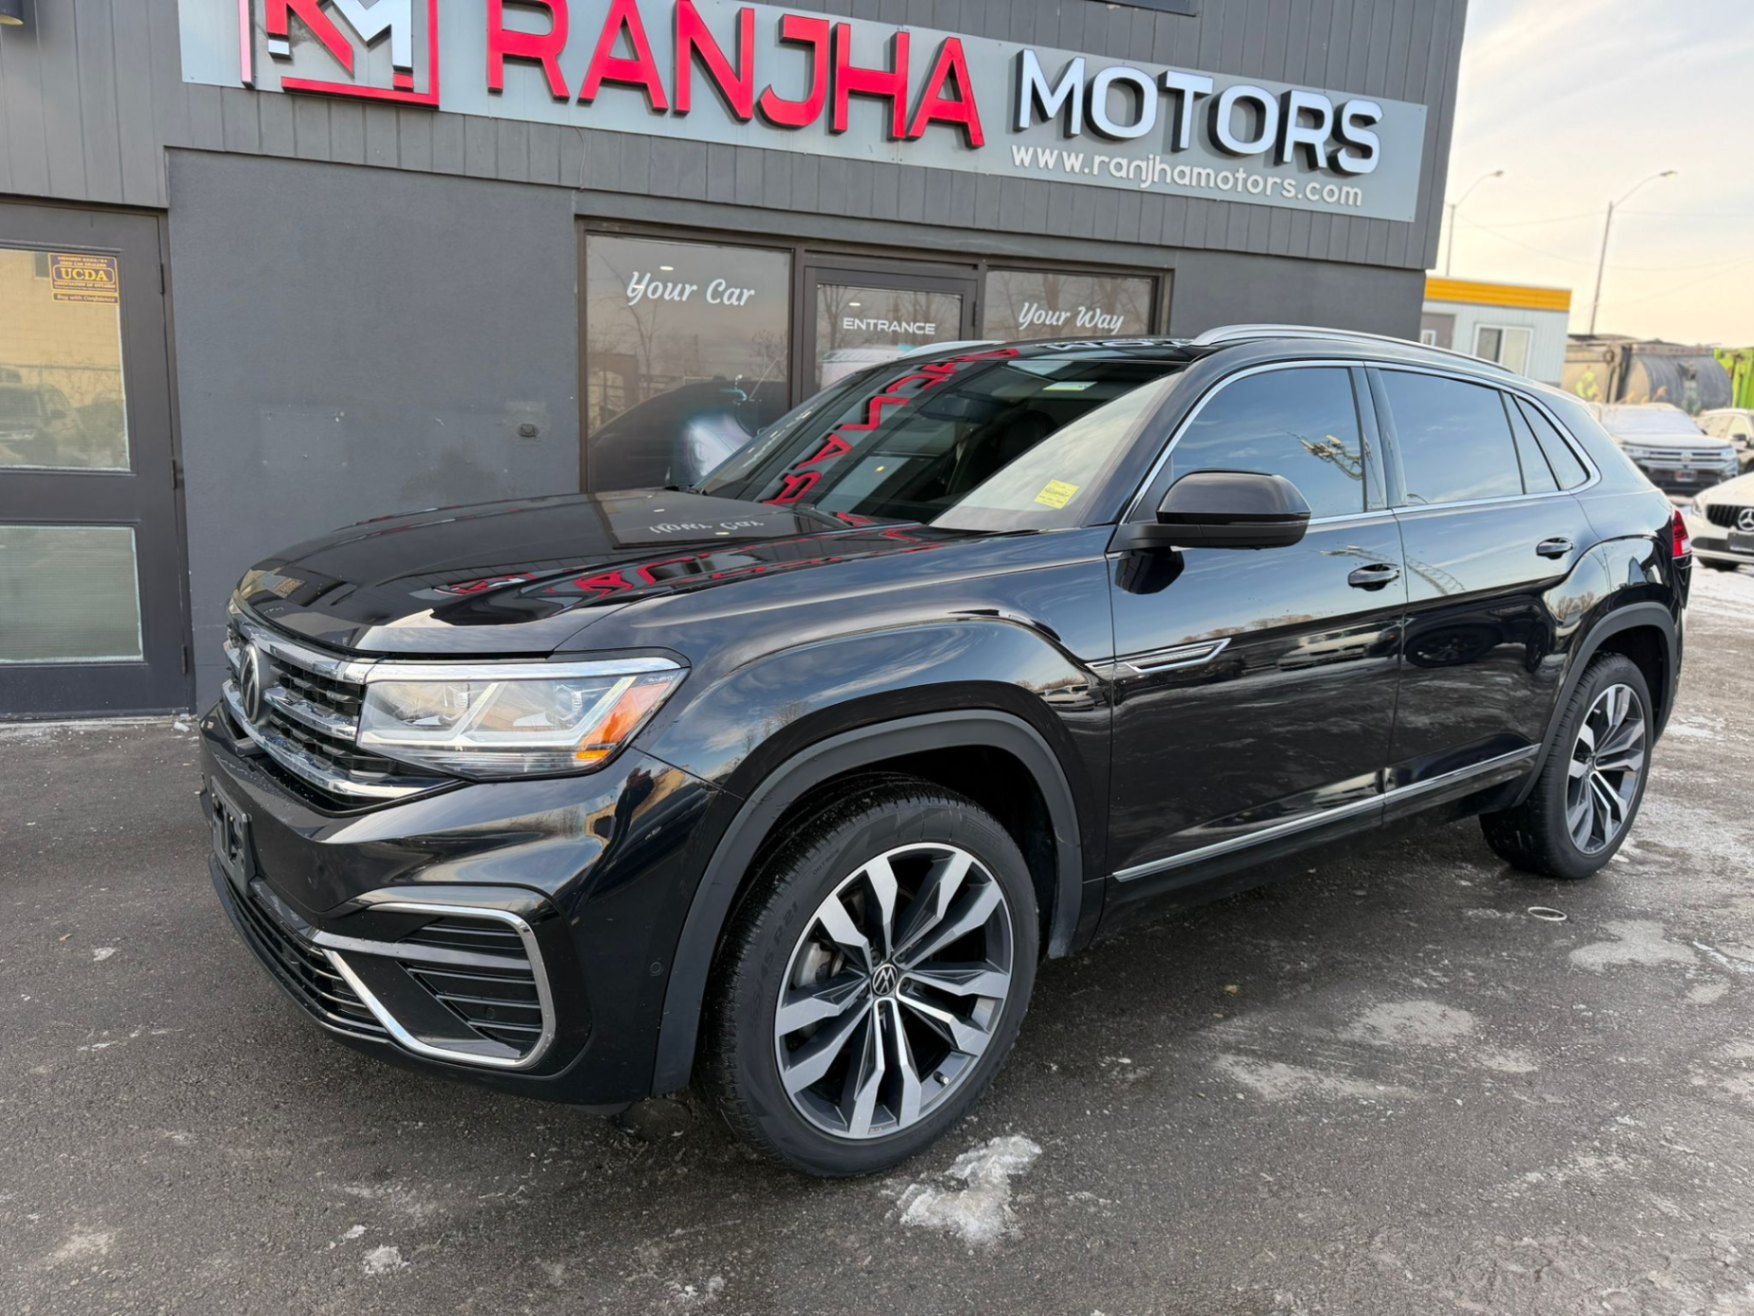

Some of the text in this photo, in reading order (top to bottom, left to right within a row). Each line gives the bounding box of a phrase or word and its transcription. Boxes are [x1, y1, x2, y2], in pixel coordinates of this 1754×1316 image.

[486, 0, 1383, 175] RANJHA MOTORS
[1011, 144, 1363, 207] www.ranjhamotors.com
[60, 267, 109, 282] UCDA
[626, 271, 756, 306] Your Car
[842, 317, 936, 335] ENTRANCE
[1018, 302, 1125, 334] Your Way
